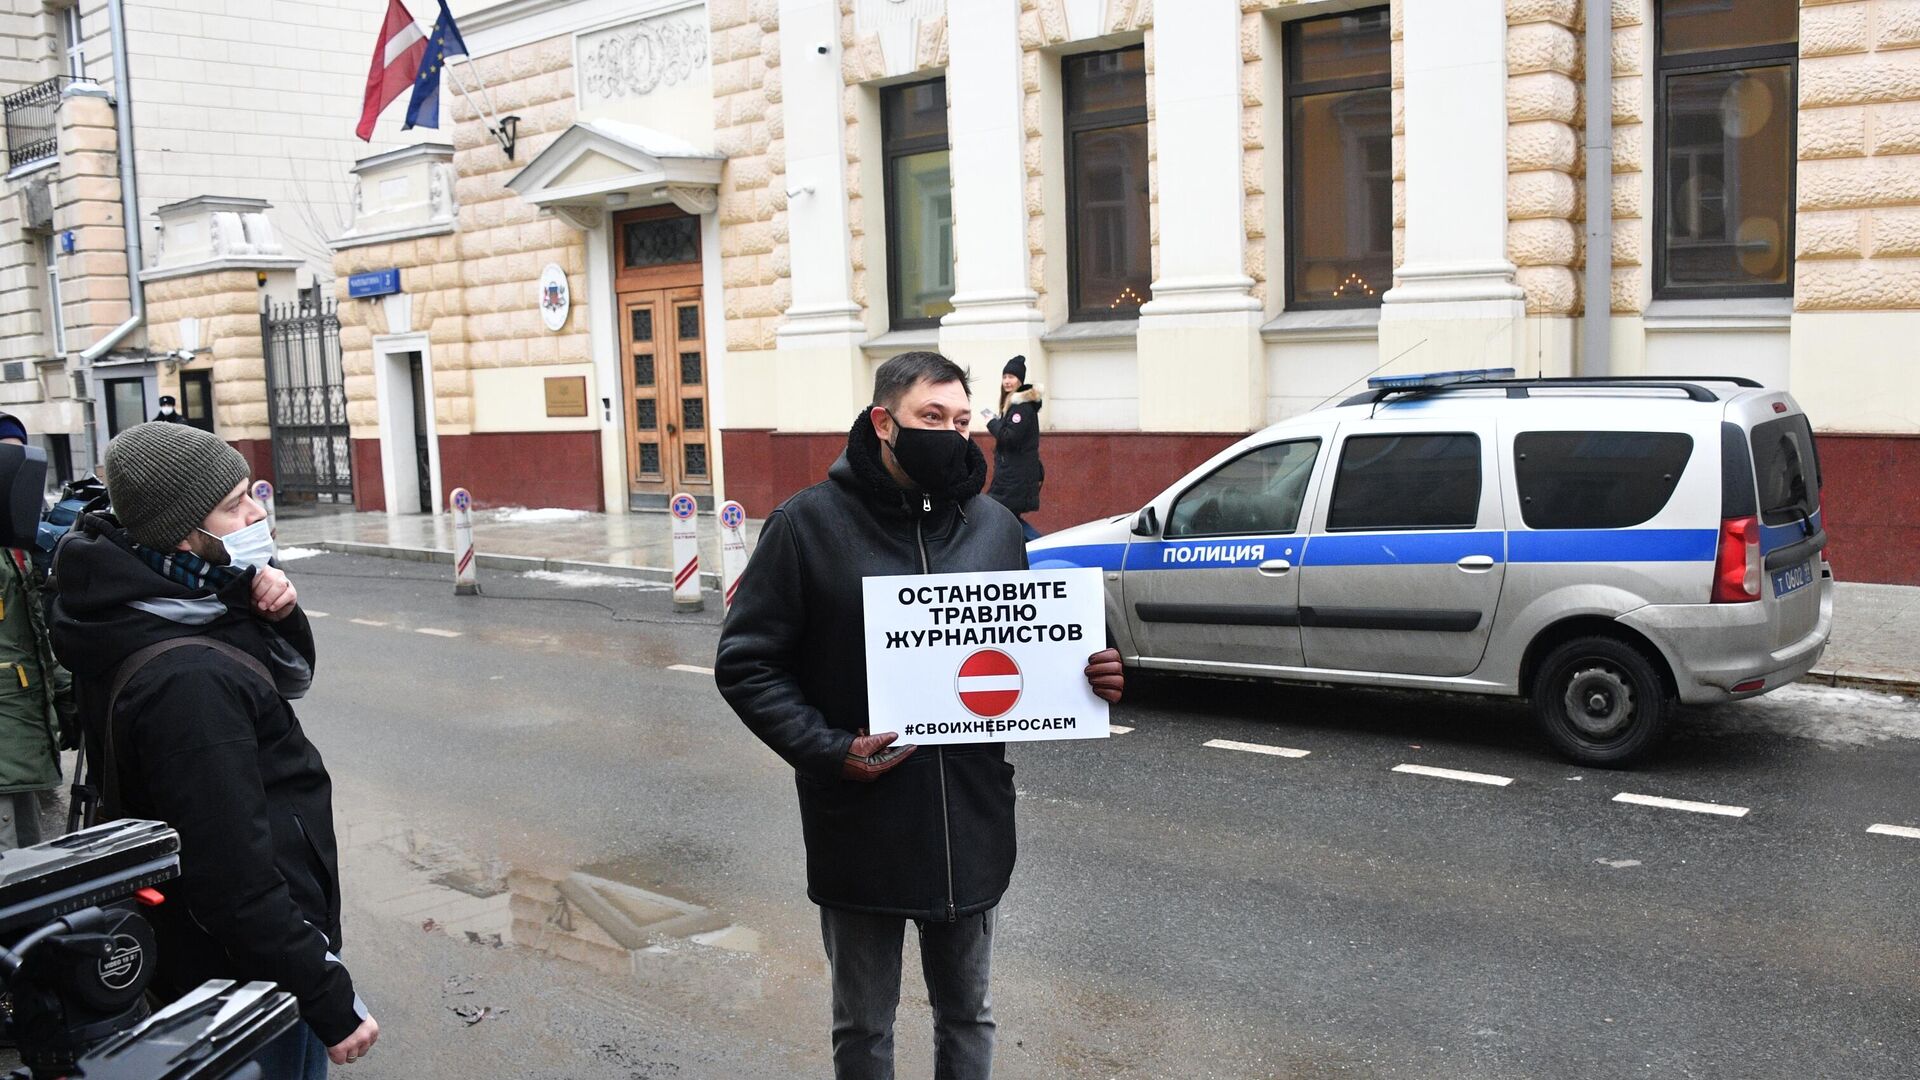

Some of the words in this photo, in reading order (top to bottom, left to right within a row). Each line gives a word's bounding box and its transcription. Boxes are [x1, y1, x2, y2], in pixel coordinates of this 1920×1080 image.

[1163, 545, 1265, 564] ПОЛИЦИЯ
[898, 581, 1067, 605] ОСТАНОВИТЕ
[929, 604, 1037, 625] ТРАВЛЮ
[885, 624, 1083, 649] ЖУРНАЛИСТОВ
[904, 717, 1076, 736] #СВОИХНЕБРОСАЕМ
